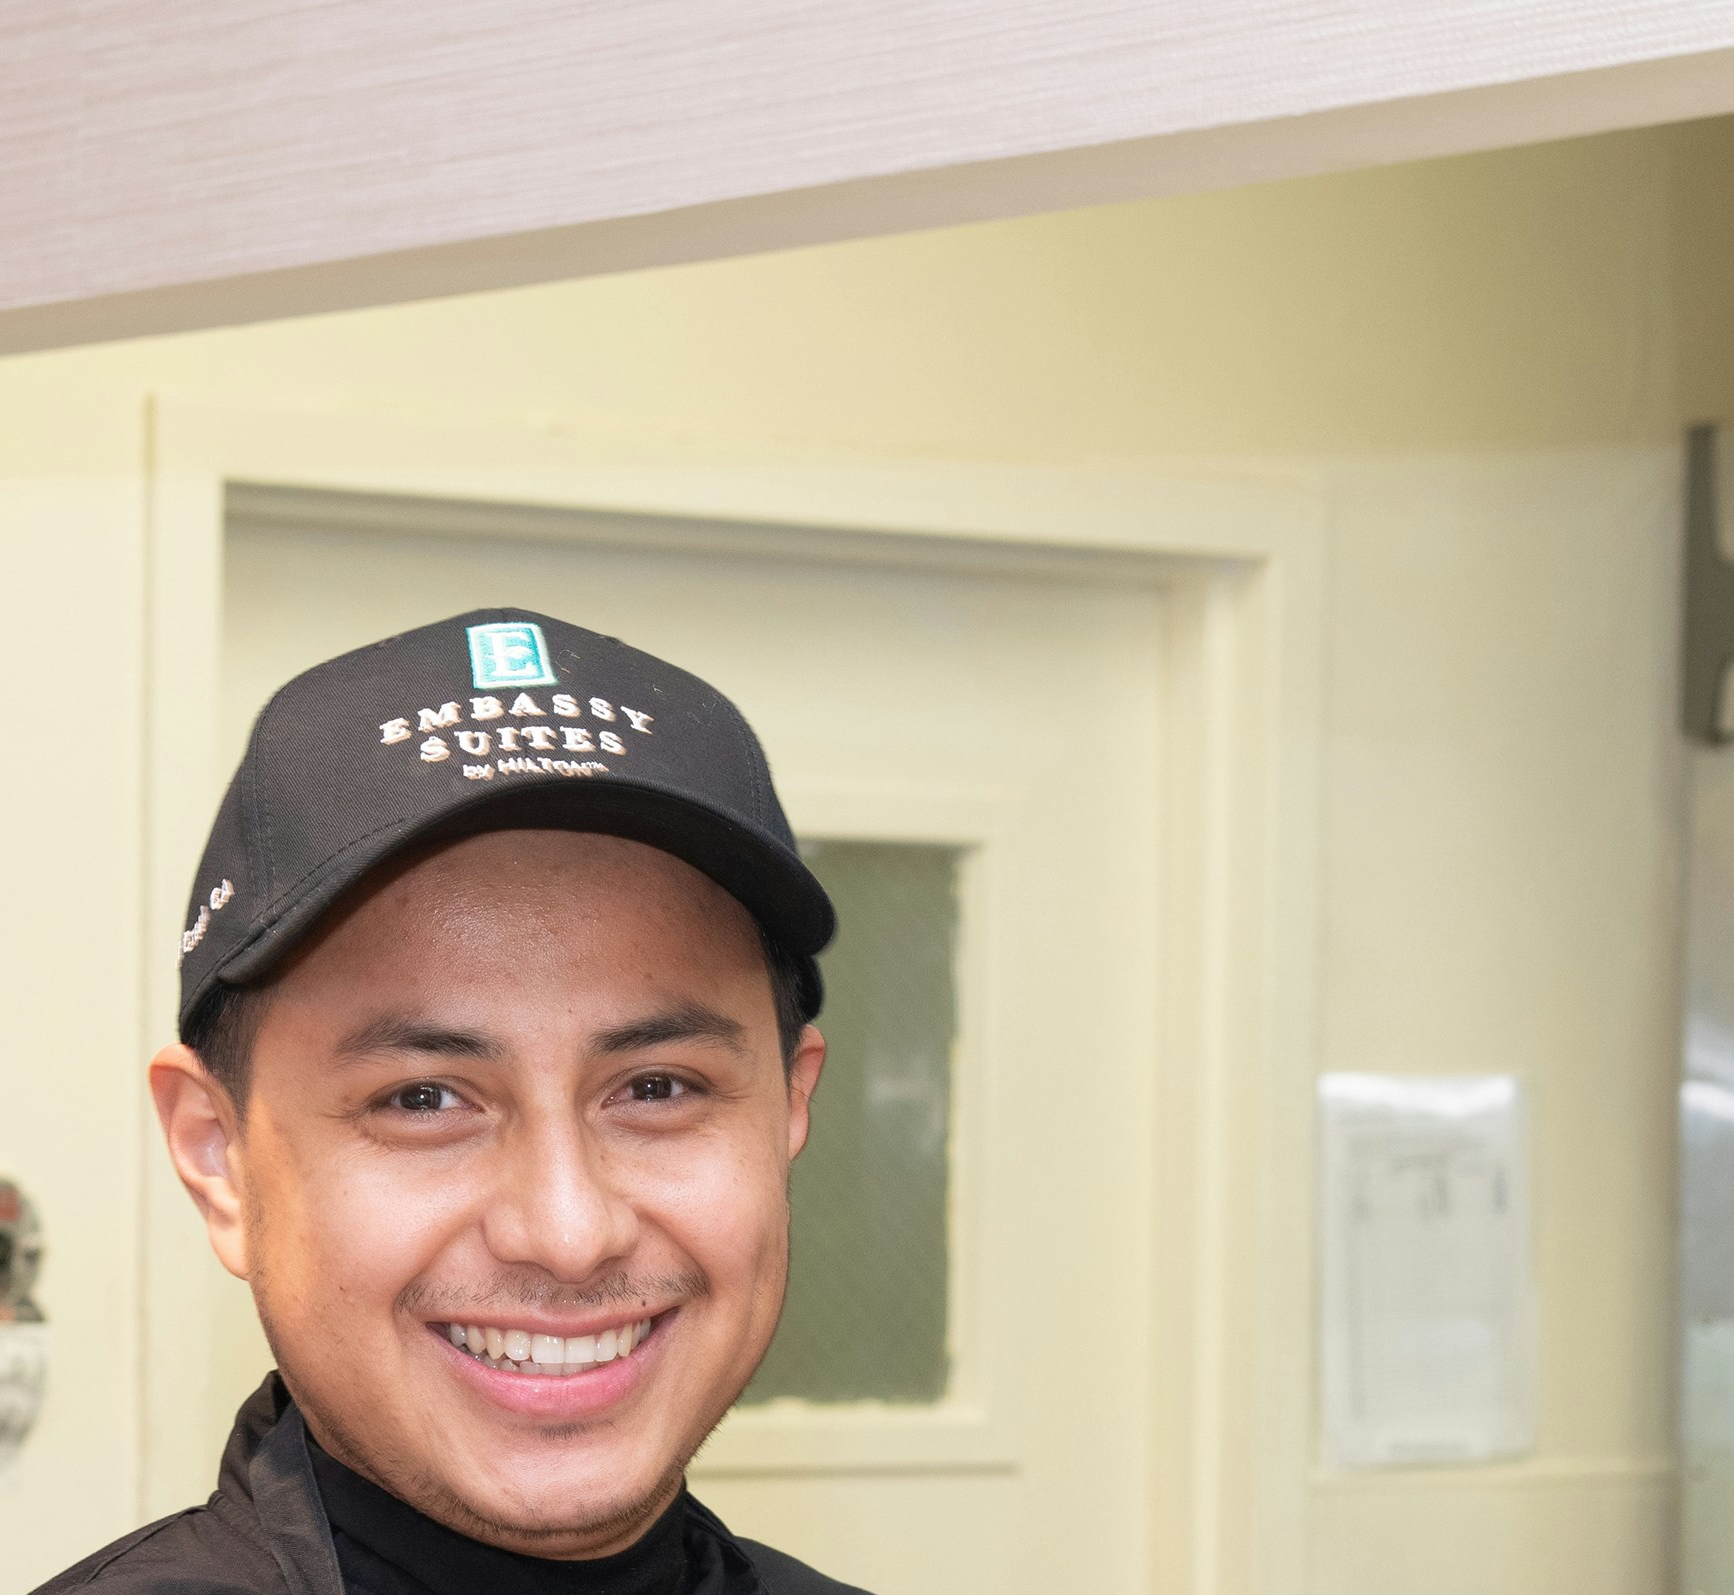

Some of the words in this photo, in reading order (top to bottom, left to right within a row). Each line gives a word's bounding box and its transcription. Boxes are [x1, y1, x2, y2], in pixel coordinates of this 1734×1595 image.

[486, 631, 540, 678] E
[379, 692, 655, 746] EMBASSY
[420, 726, 627, 763] SUITES
